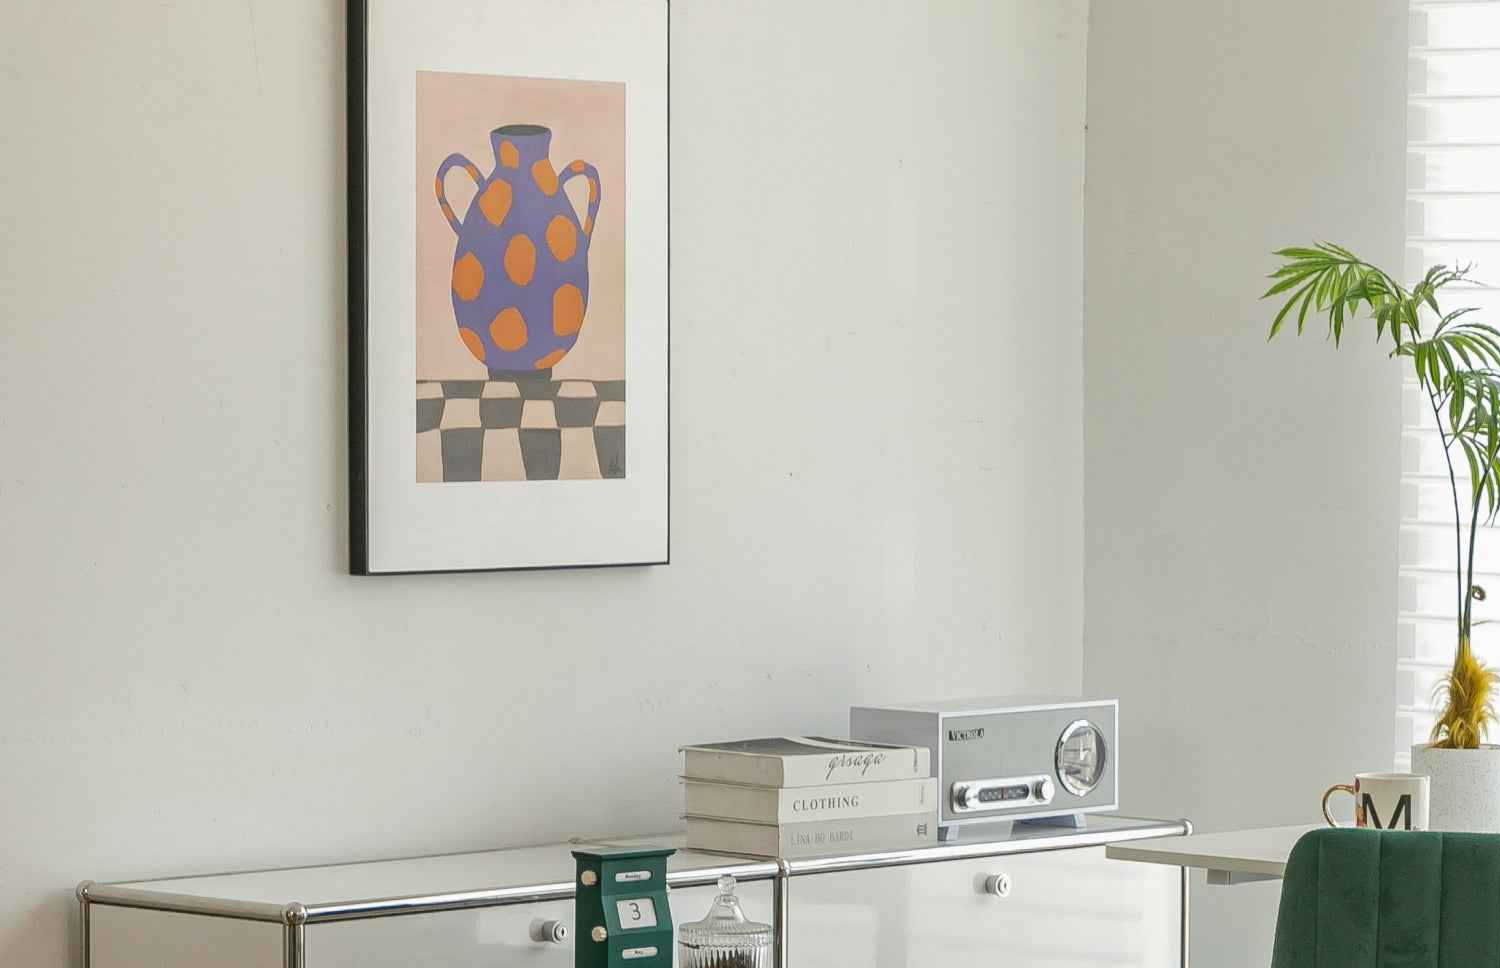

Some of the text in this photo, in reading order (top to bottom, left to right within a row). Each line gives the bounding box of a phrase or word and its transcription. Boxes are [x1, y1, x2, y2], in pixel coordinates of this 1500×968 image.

[792, 796, 859, 812] CLOTHING
[1361, 792, 1411, 830] M
[628, 902, 641, 921] 3
